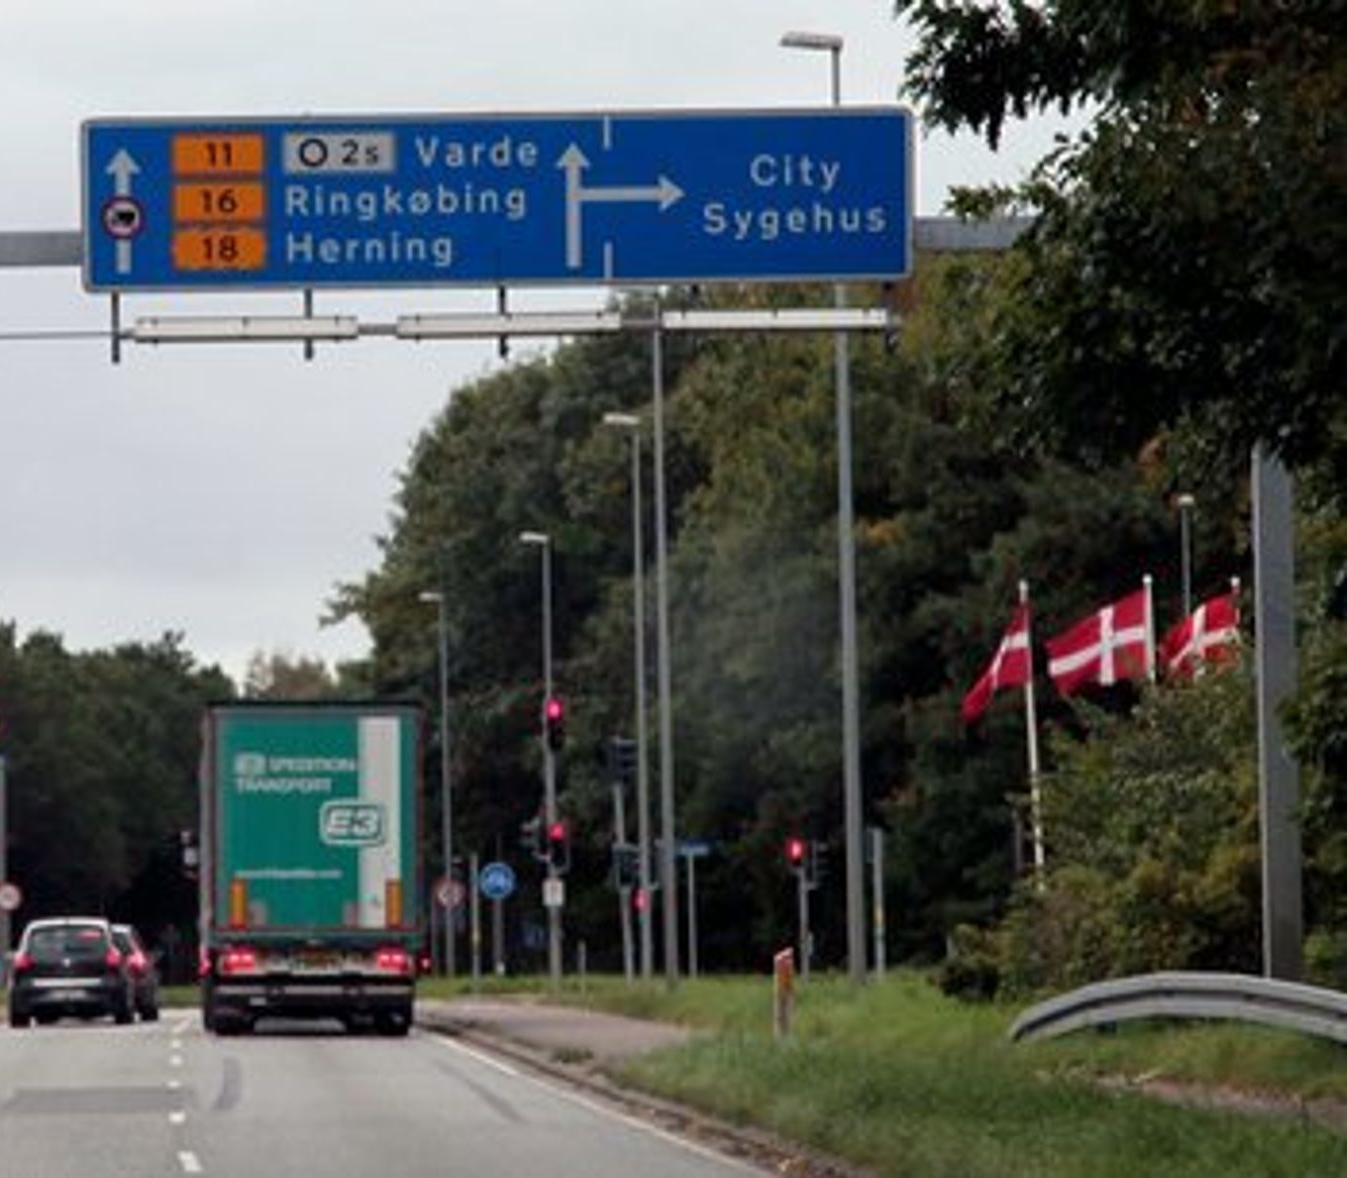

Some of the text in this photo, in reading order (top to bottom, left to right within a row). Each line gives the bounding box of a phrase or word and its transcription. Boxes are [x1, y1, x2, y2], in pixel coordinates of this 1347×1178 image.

[206, 141, 232, 165] 11
[415, 136, 538, 168] Varde
[749, 153, 840, 191] City
[201, 189, 238, 215] 16
[285, 183, 527, 221] Ringkøbing
[702, 203, 886, 240] Sygehus
[201, 235, 239, 259] 18
[286, 232, 454, 266] Herning
